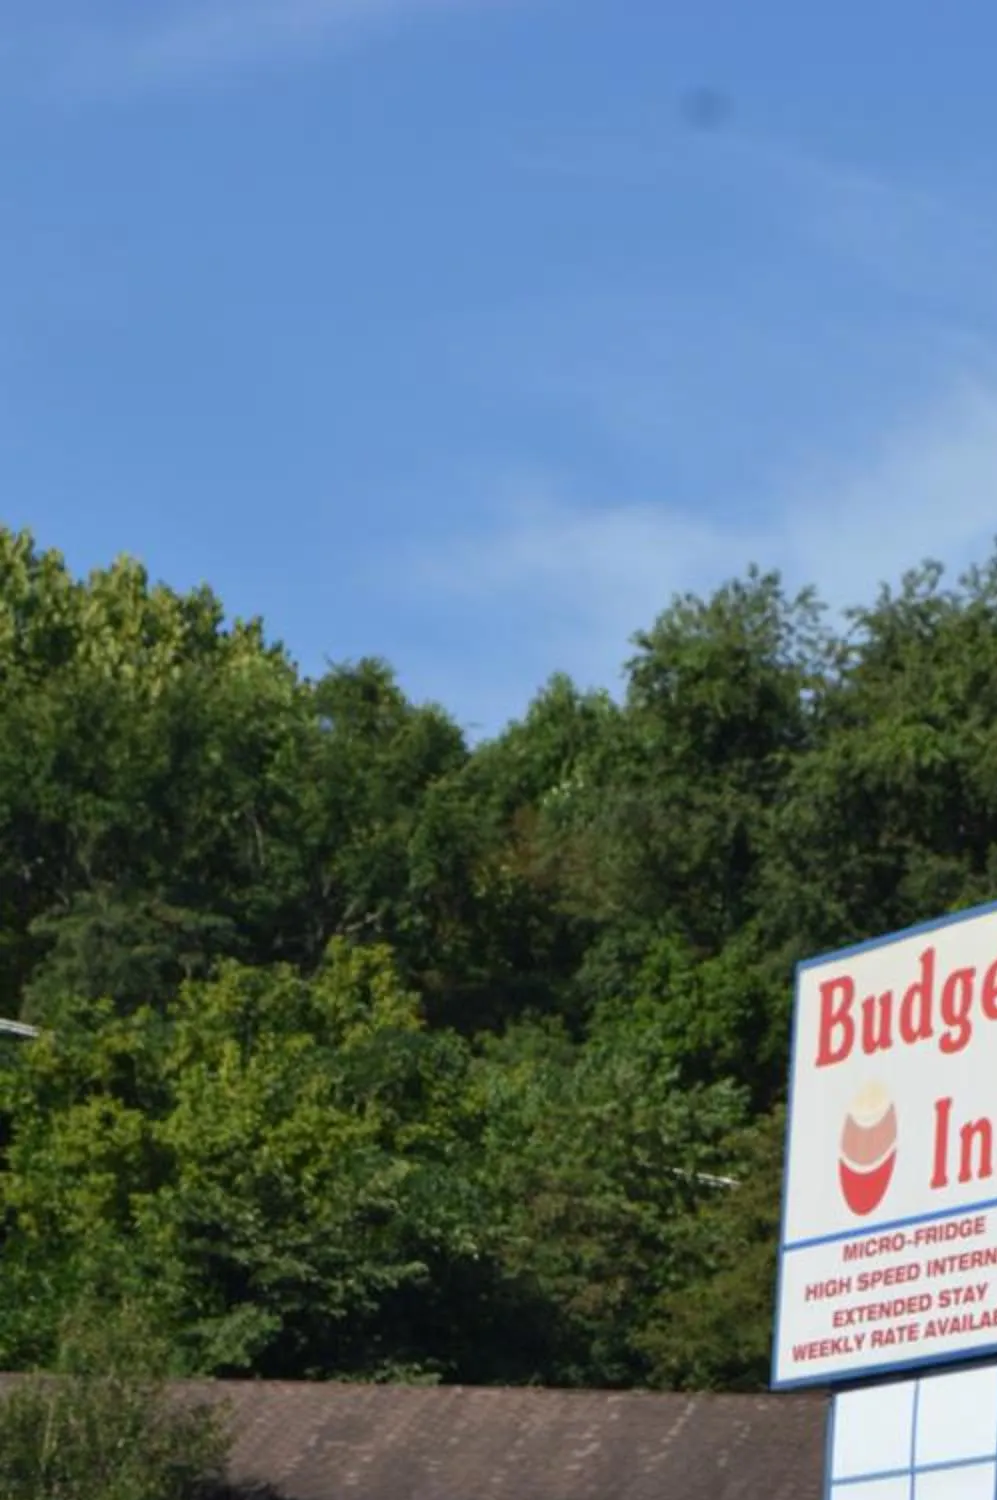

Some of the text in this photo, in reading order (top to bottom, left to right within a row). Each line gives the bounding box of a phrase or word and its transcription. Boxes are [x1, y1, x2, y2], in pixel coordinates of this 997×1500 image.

[842, 1215, 987, 1262] MICRO-FRIDGE
[804, 1276, 852, 1302] HIGH
[856, 1263, 921, 1293] SPEED
[832, 1282, 989, 1329] EXTENDED STAY
[791, 1334, 866, 1363] WEEKLY
[870, 1322, 920, 1349] RATE
